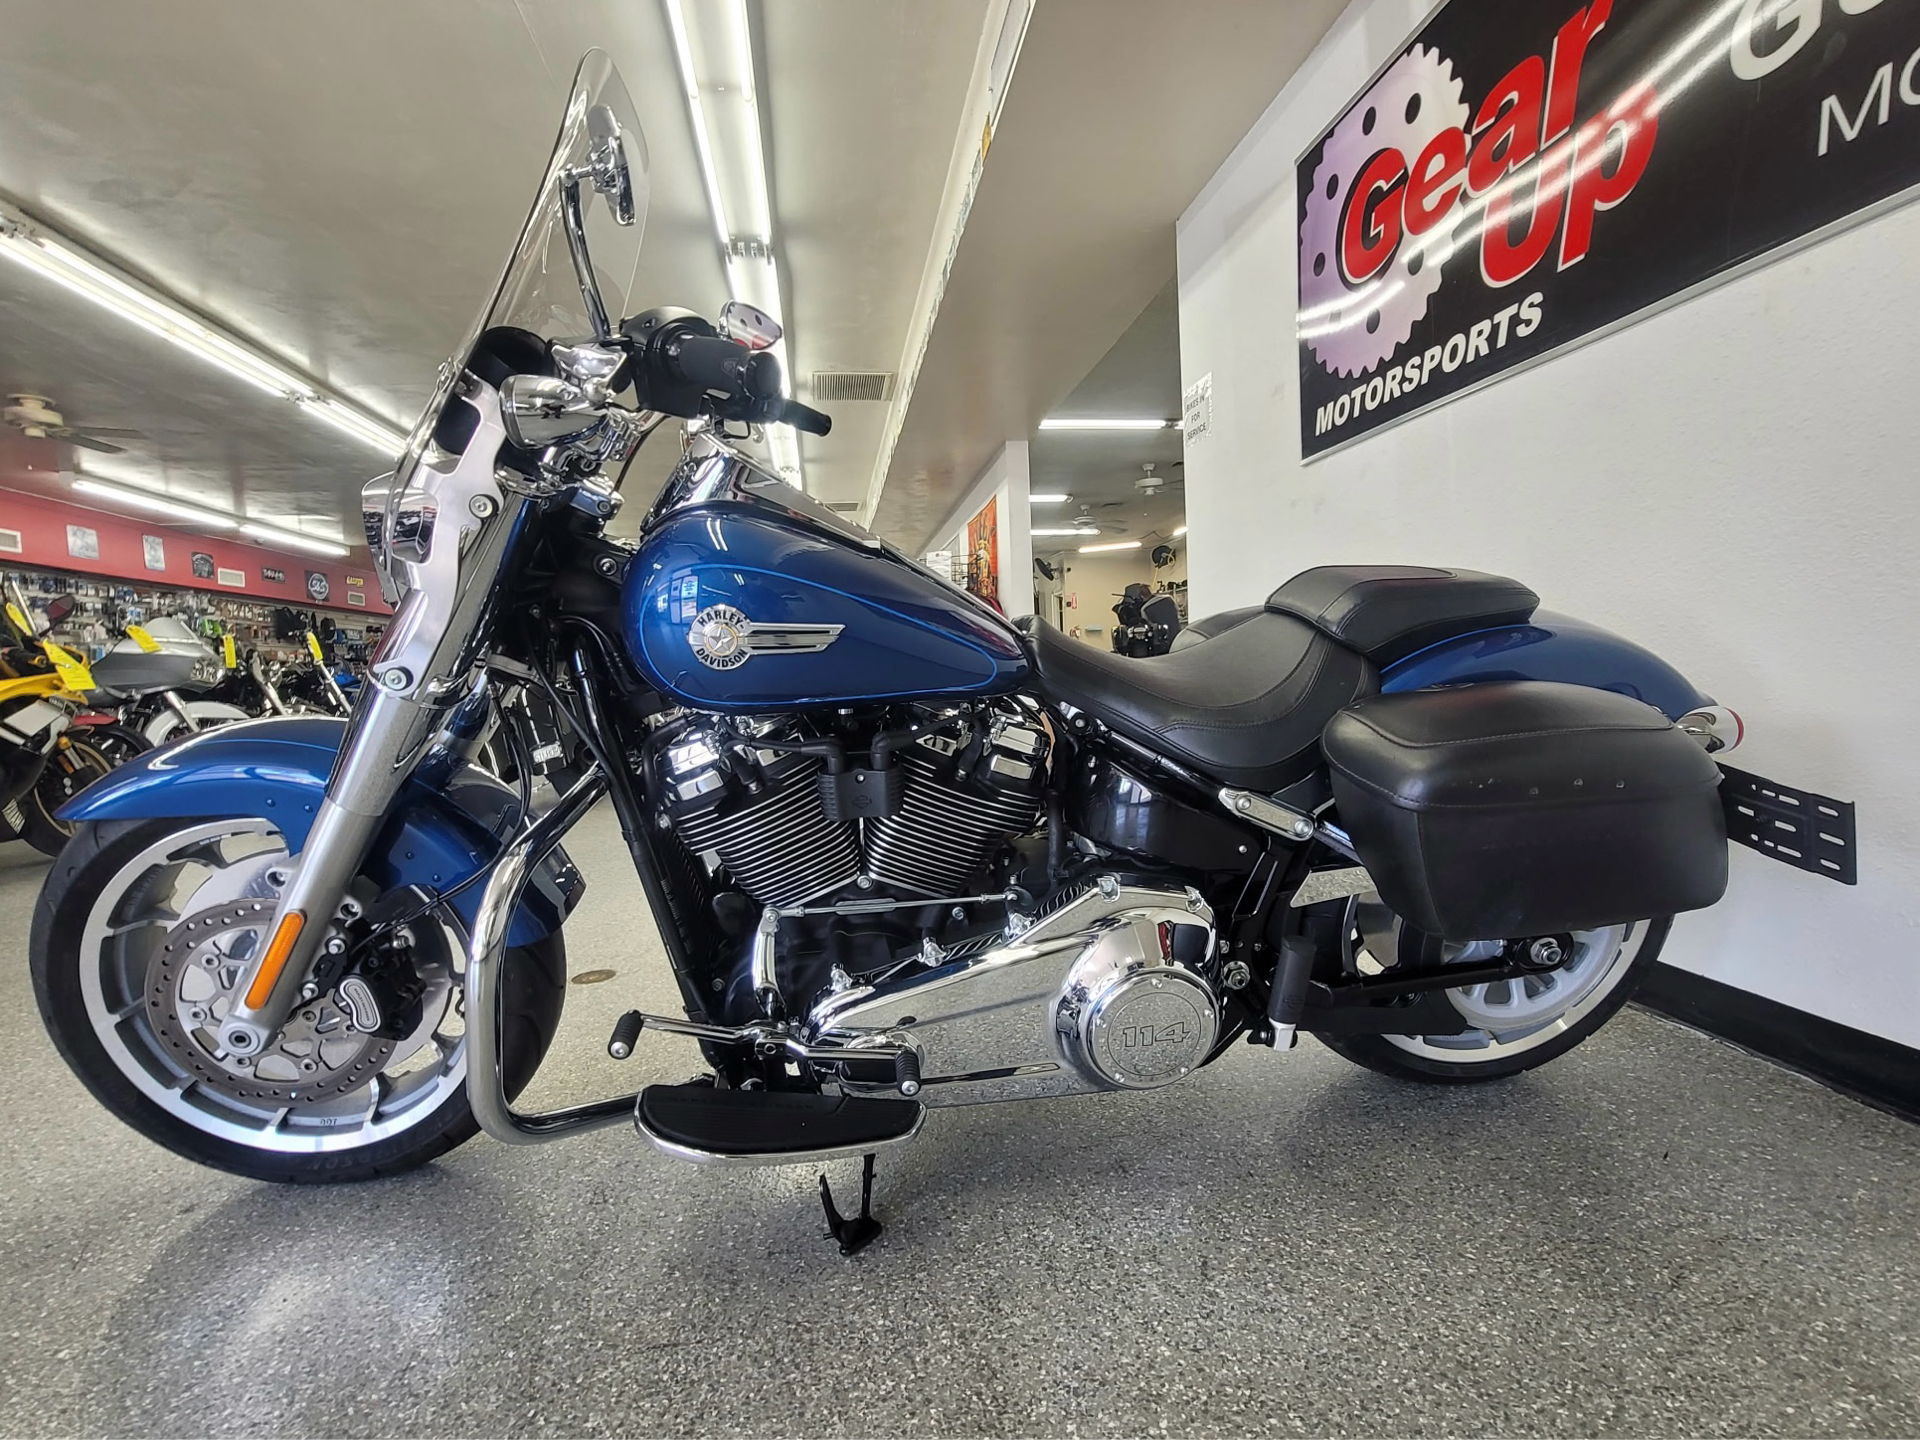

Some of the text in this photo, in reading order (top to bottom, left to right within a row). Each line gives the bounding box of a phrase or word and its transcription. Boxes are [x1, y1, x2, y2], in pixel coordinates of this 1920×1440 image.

[1341, 0, 1612, 286] Gear
[1481, 80, 1660, 289] Up
[1314, 291, 1544, 437] MOTORSPORTS
[1190, 411, 1201, 423] FOR
[1187, 422, 1207, 440] SERVICE
[695, 647, 748, 668] DAVIDSON
[1122, 1021, 1191, 1048] 114
